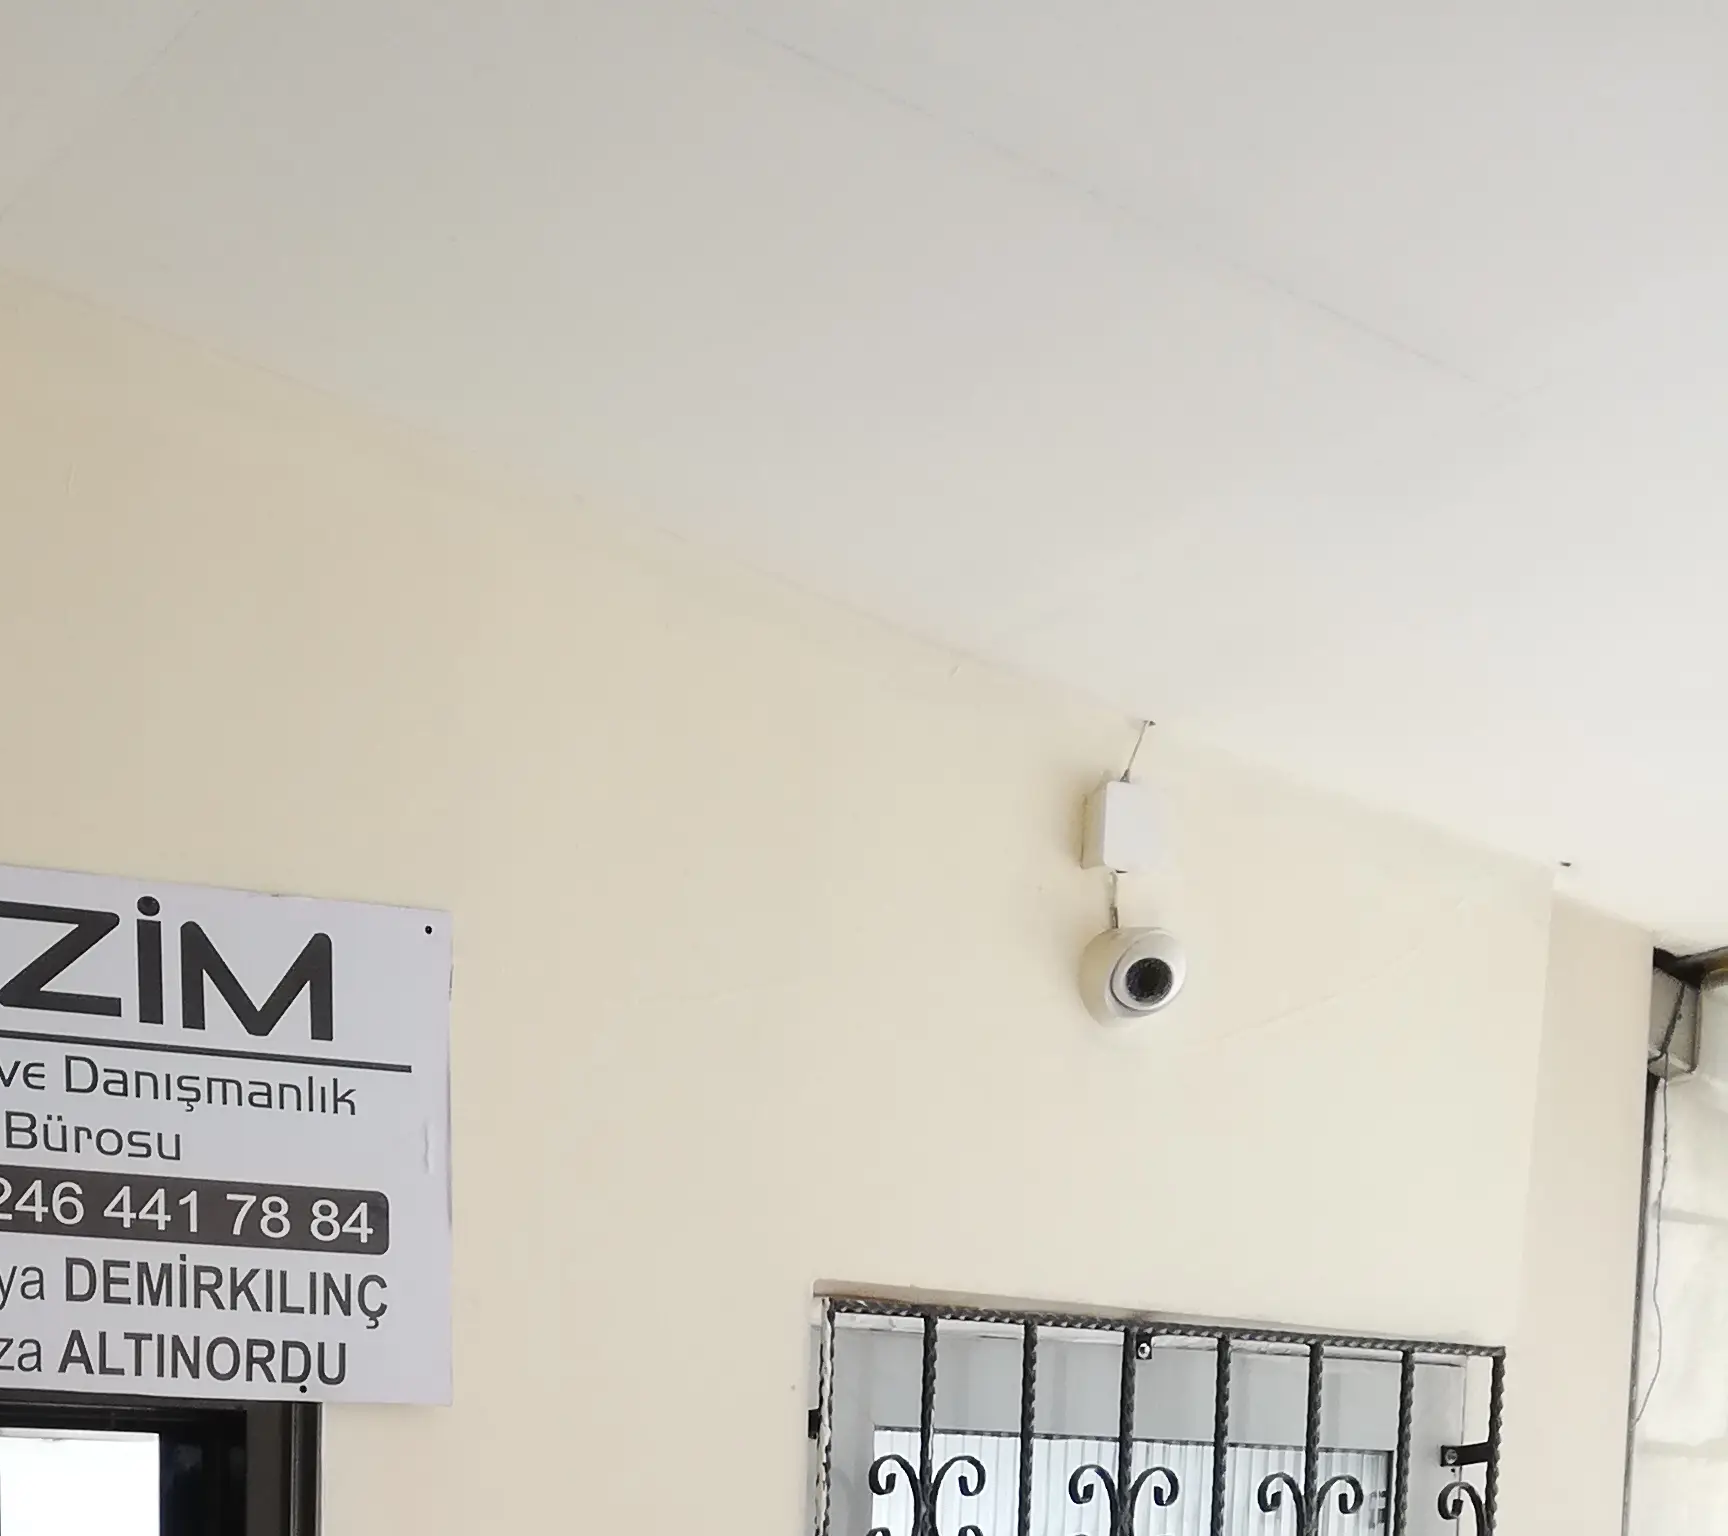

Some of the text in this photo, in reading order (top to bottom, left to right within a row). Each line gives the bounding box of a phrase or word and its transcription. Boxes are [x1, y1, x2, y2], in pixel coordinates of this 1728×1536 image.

[64, 1054, 357, 1117] Danışmanlık
[5, 1110, 181, 1162] Bürosu
[103, 1185, 200, 1234] 441
[226, 1193, 292, 1239] 78
[309, 1199, 374, 1244] 84
[65, 1253, 389, 1331] DEMİRKILINÇ
[57, 1329, 347, 1387] ALTINORDU
